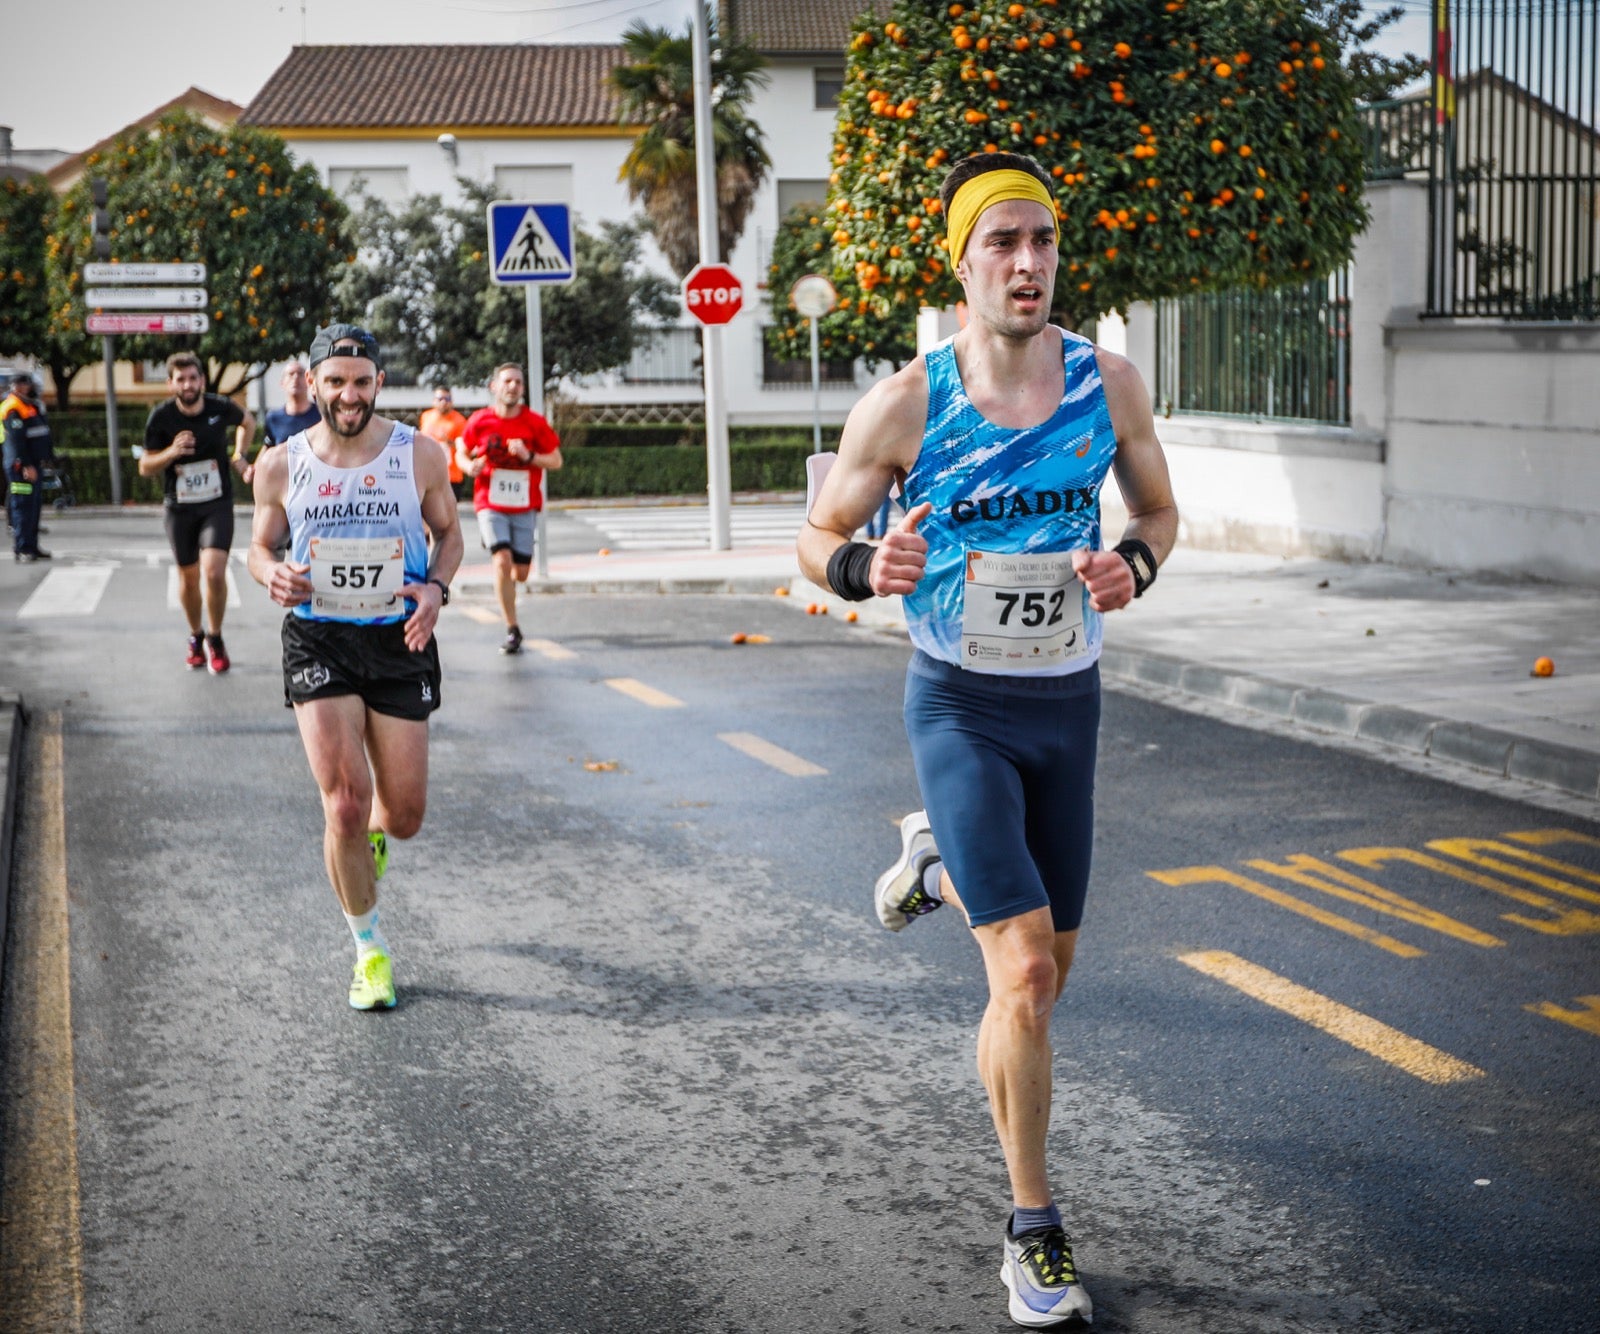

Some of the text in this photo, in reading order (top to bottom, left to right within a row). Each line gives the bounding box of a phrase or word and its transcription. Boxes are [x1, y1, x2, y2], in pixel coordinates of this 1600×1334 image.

[688, 287, 742, 306] STOP
[186, 472, 209, 488] 507
[304, 502, 400, 521] MARACENA
[951, 486, 1096, 522] GUADIX
[331, 564, 384, 589] 557
[995, 589, 1066, 627] 752
